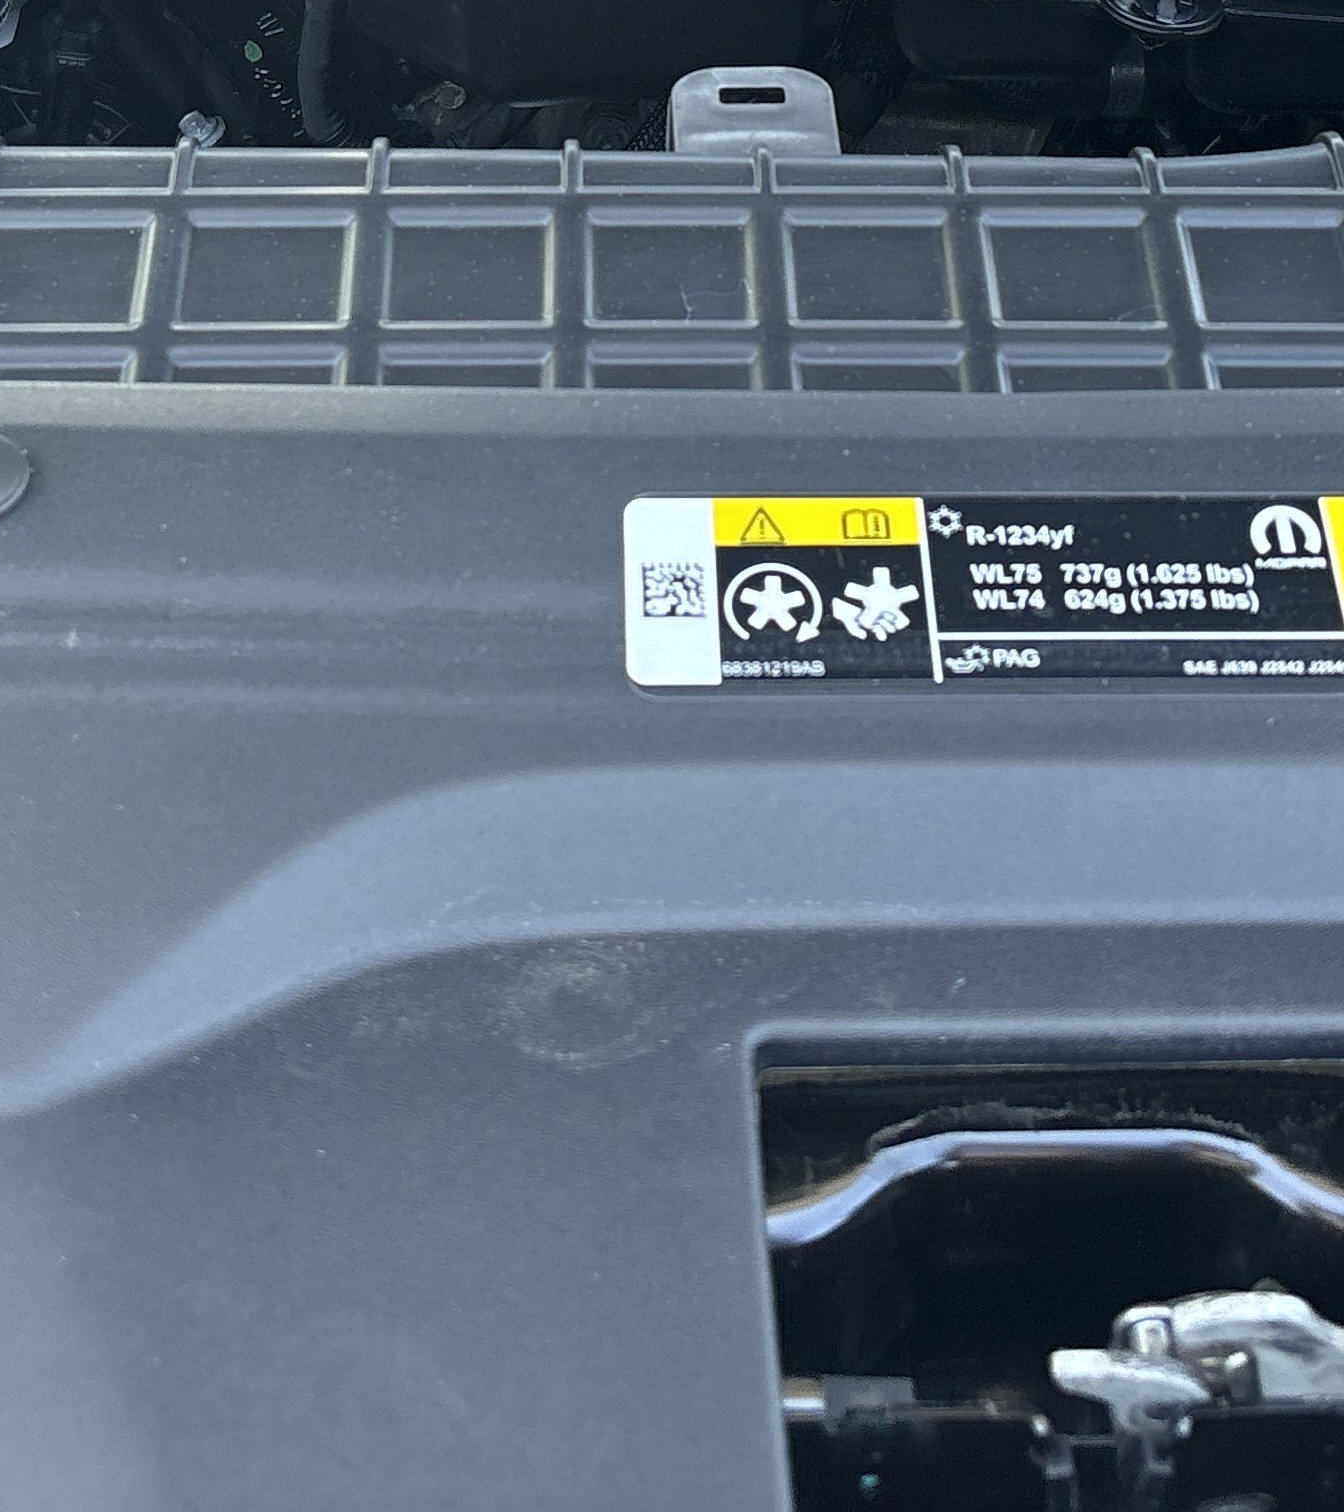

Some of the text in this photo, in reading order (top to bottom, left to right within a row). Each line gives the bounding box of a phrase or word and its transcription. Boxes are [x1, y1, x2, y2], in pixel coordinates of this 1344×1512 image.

[965, 524, 1075, 550] R-1234yf
[969, 562, 1255, 589] WL75 737g (1.625 lbs)
[972, 588, 1260, 614] WL74 624g (1.375 lbs)
[992, 648, 1041, 669] PAG
